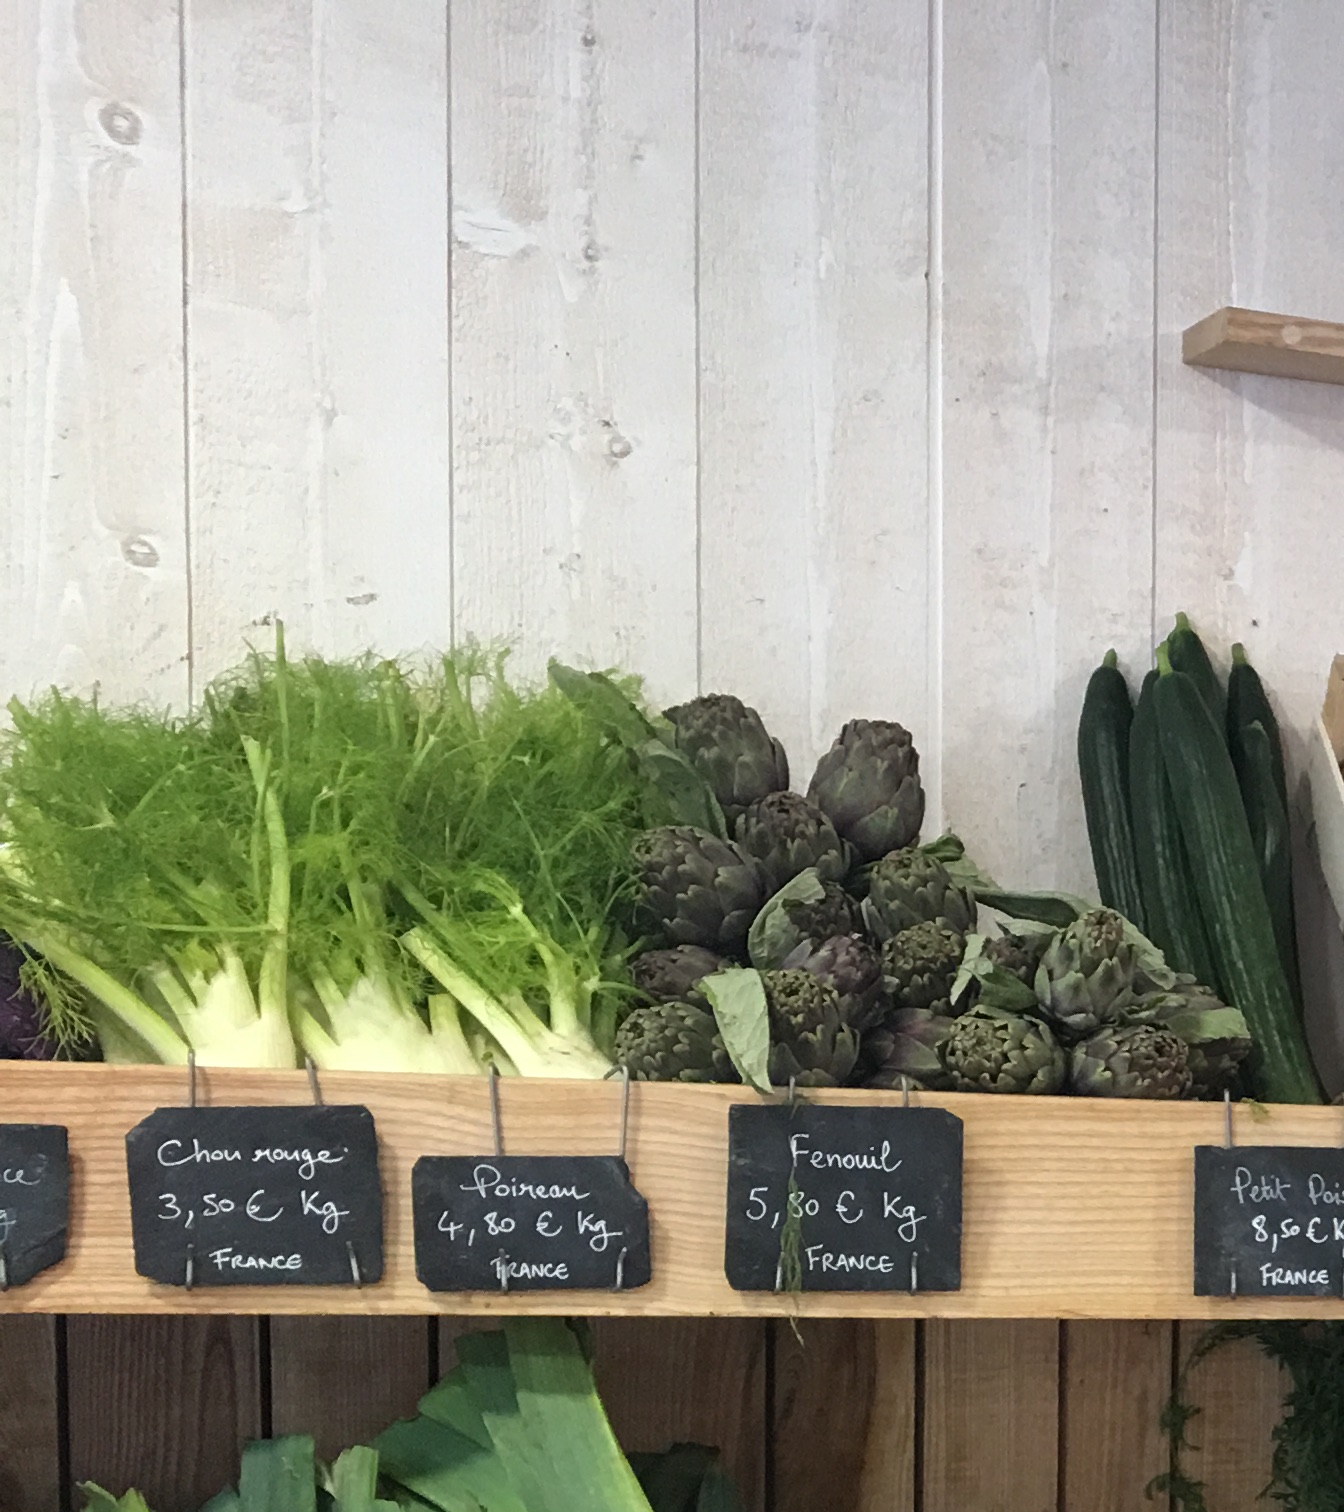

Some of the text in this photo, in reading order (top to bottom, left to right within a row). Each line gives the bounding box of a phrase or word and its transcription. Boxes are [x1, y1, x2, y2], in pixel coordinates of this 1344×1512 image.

[251, 1149, 344, 1180] rouge
[790, 1134, 902, 1172] Fenouil
[460, 1164, 590, 1200] Poireau
[1230, 1167, 1290, 1204] Petit
[301, 1190, 349, 1234] Kg
[883, 1192, 927, 1242] Kg
[437, 1211, 515, 1246] 4,80
[577, 1210, 623, 1252] Kg
[208, 1248, 303, 1271] FRANCE
[490, 1255, 569, 1280] FRANCE
[805, 1244, 894, 1272] FRANCE
[1260, 1262, 1329, 1286] FRANCE
